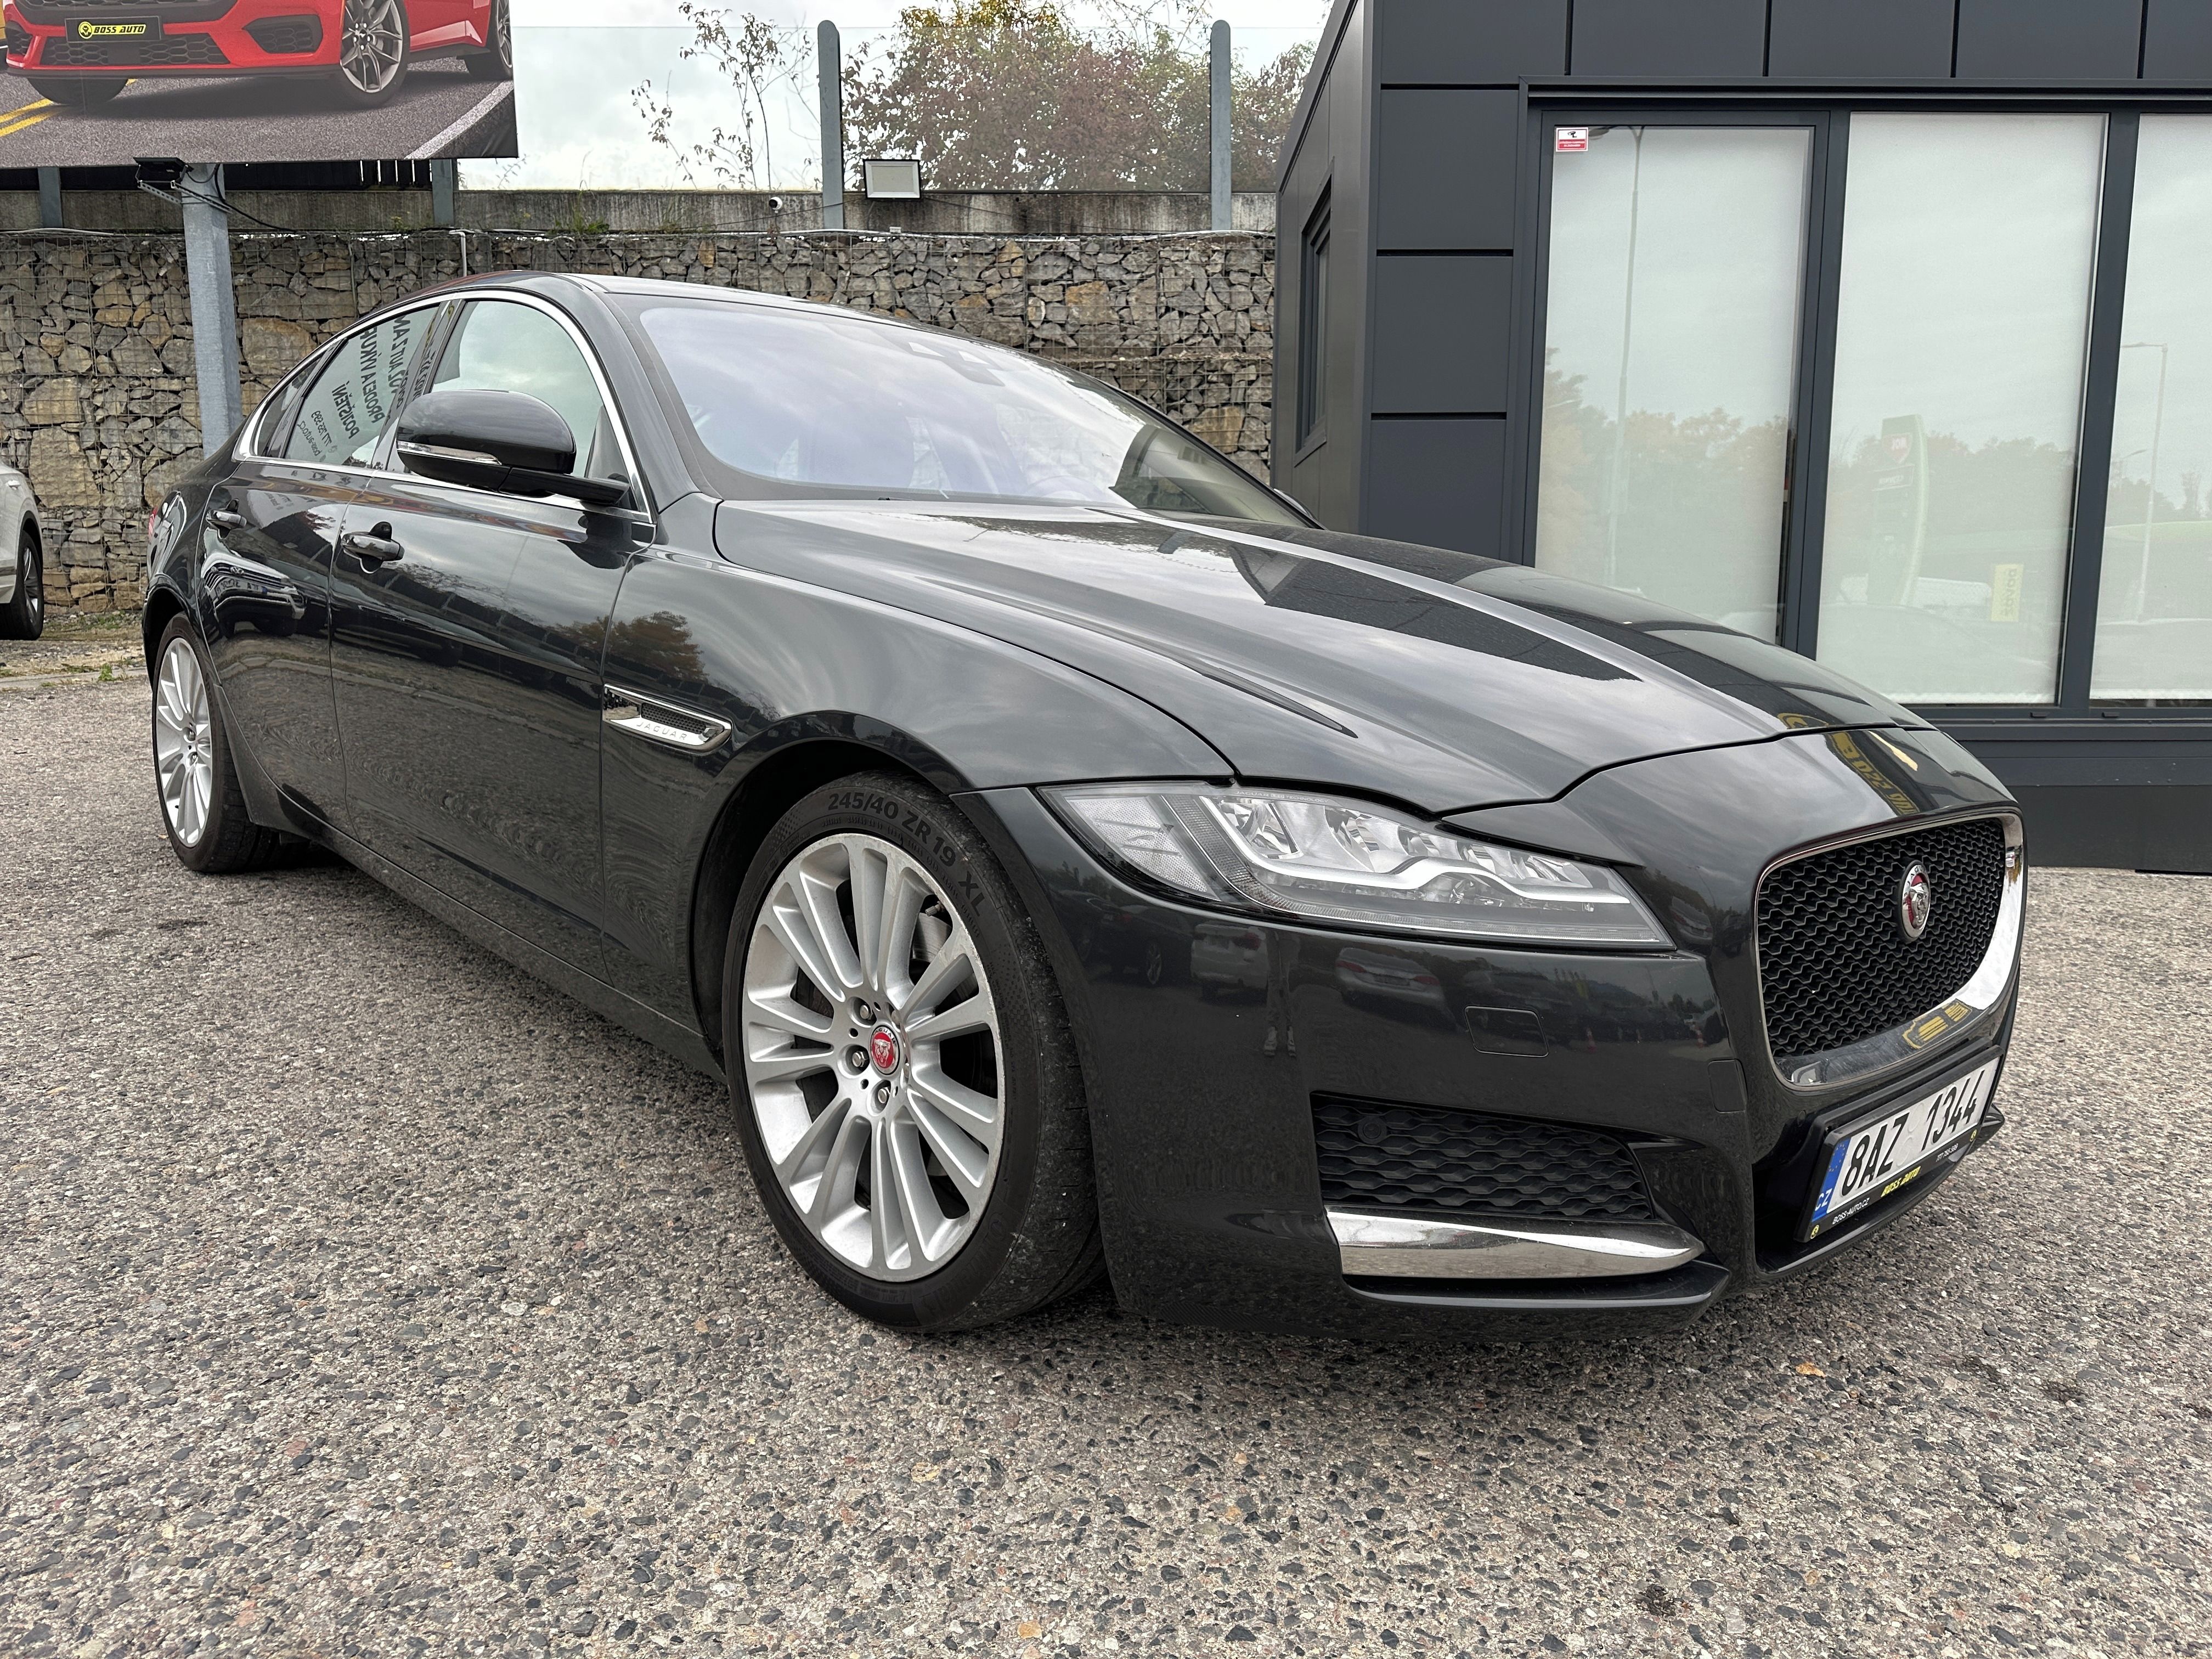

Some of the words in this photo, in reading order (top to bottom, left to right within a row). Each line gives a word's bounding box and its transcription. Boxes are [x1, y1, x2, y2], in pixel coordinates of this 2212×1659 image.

[636, 722, 687, 740] JAGUAR
[1286, 795, 1329, 803] TECHNOLOGY
[828, 792, 899, 819] 245/40
[902, 810, 931, 844] ZR
[933, 836, 956, 867] 19
[958, 871, 985, 917] XL
[1842, 1112, 1910, 1196] 8AZ
[1921, 1070, 1984, 1152] 1344
[1881, 1177, 1902, 1197] BOSS
[1899, 1166, 1921, 1186] AUTO
[1815, 1188, 1832, 1211] CZ
